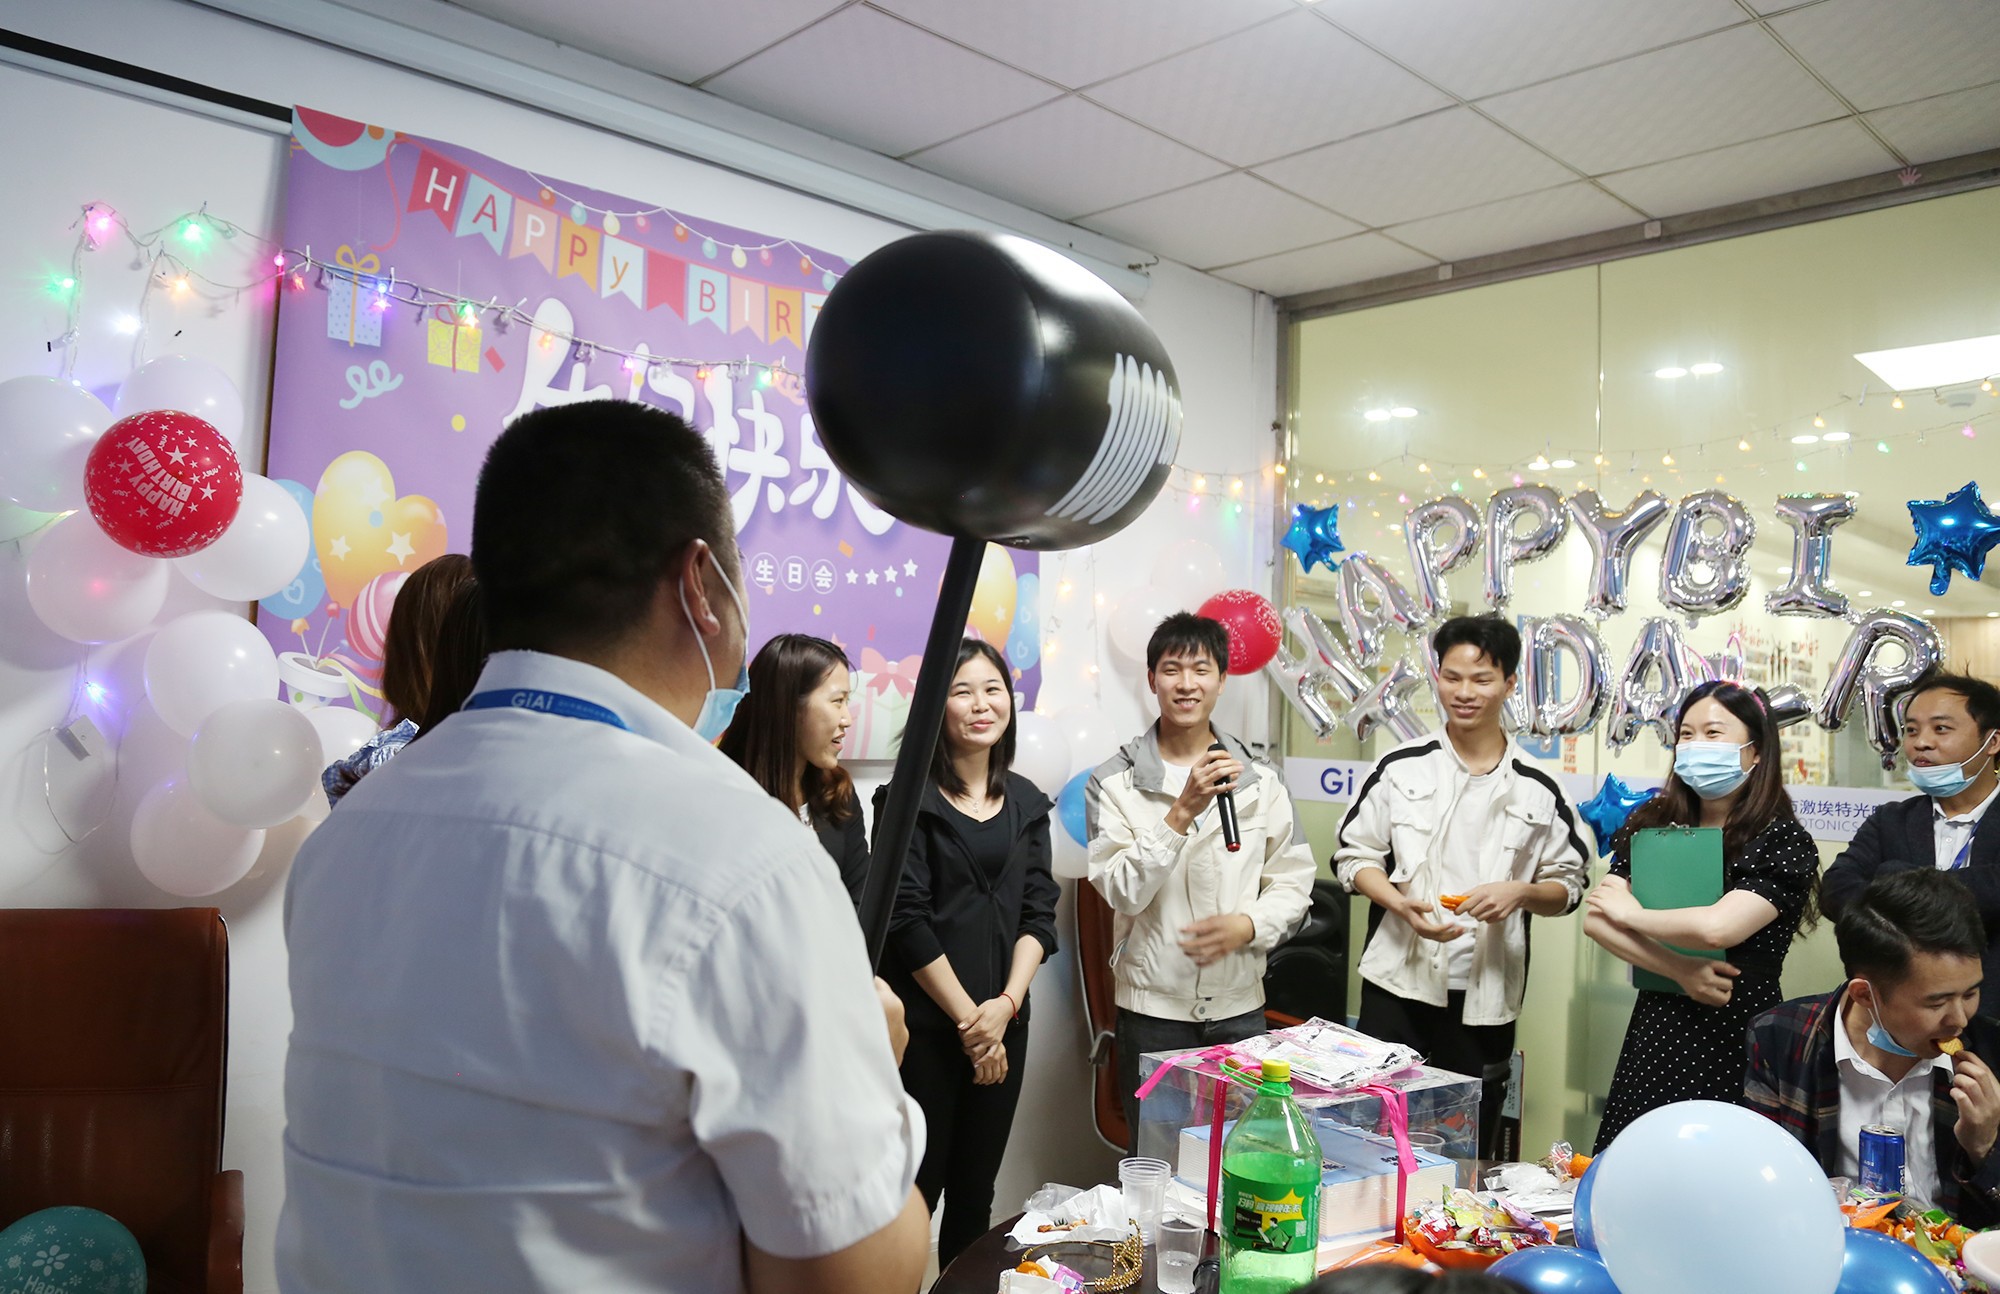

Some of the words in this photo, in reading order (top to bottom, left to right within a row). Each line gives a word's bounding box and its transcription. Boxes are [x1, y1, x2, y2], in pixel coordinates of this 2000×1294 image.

[124, 436, 193, 502] BIRTHDAY
[128, 472, 185, 517] HAPPY
[755, 559, 833, 589] 生日会
[1320, 767, 1355, 796] Gi
[1791, 799, 1877, 819] 激埃特光
